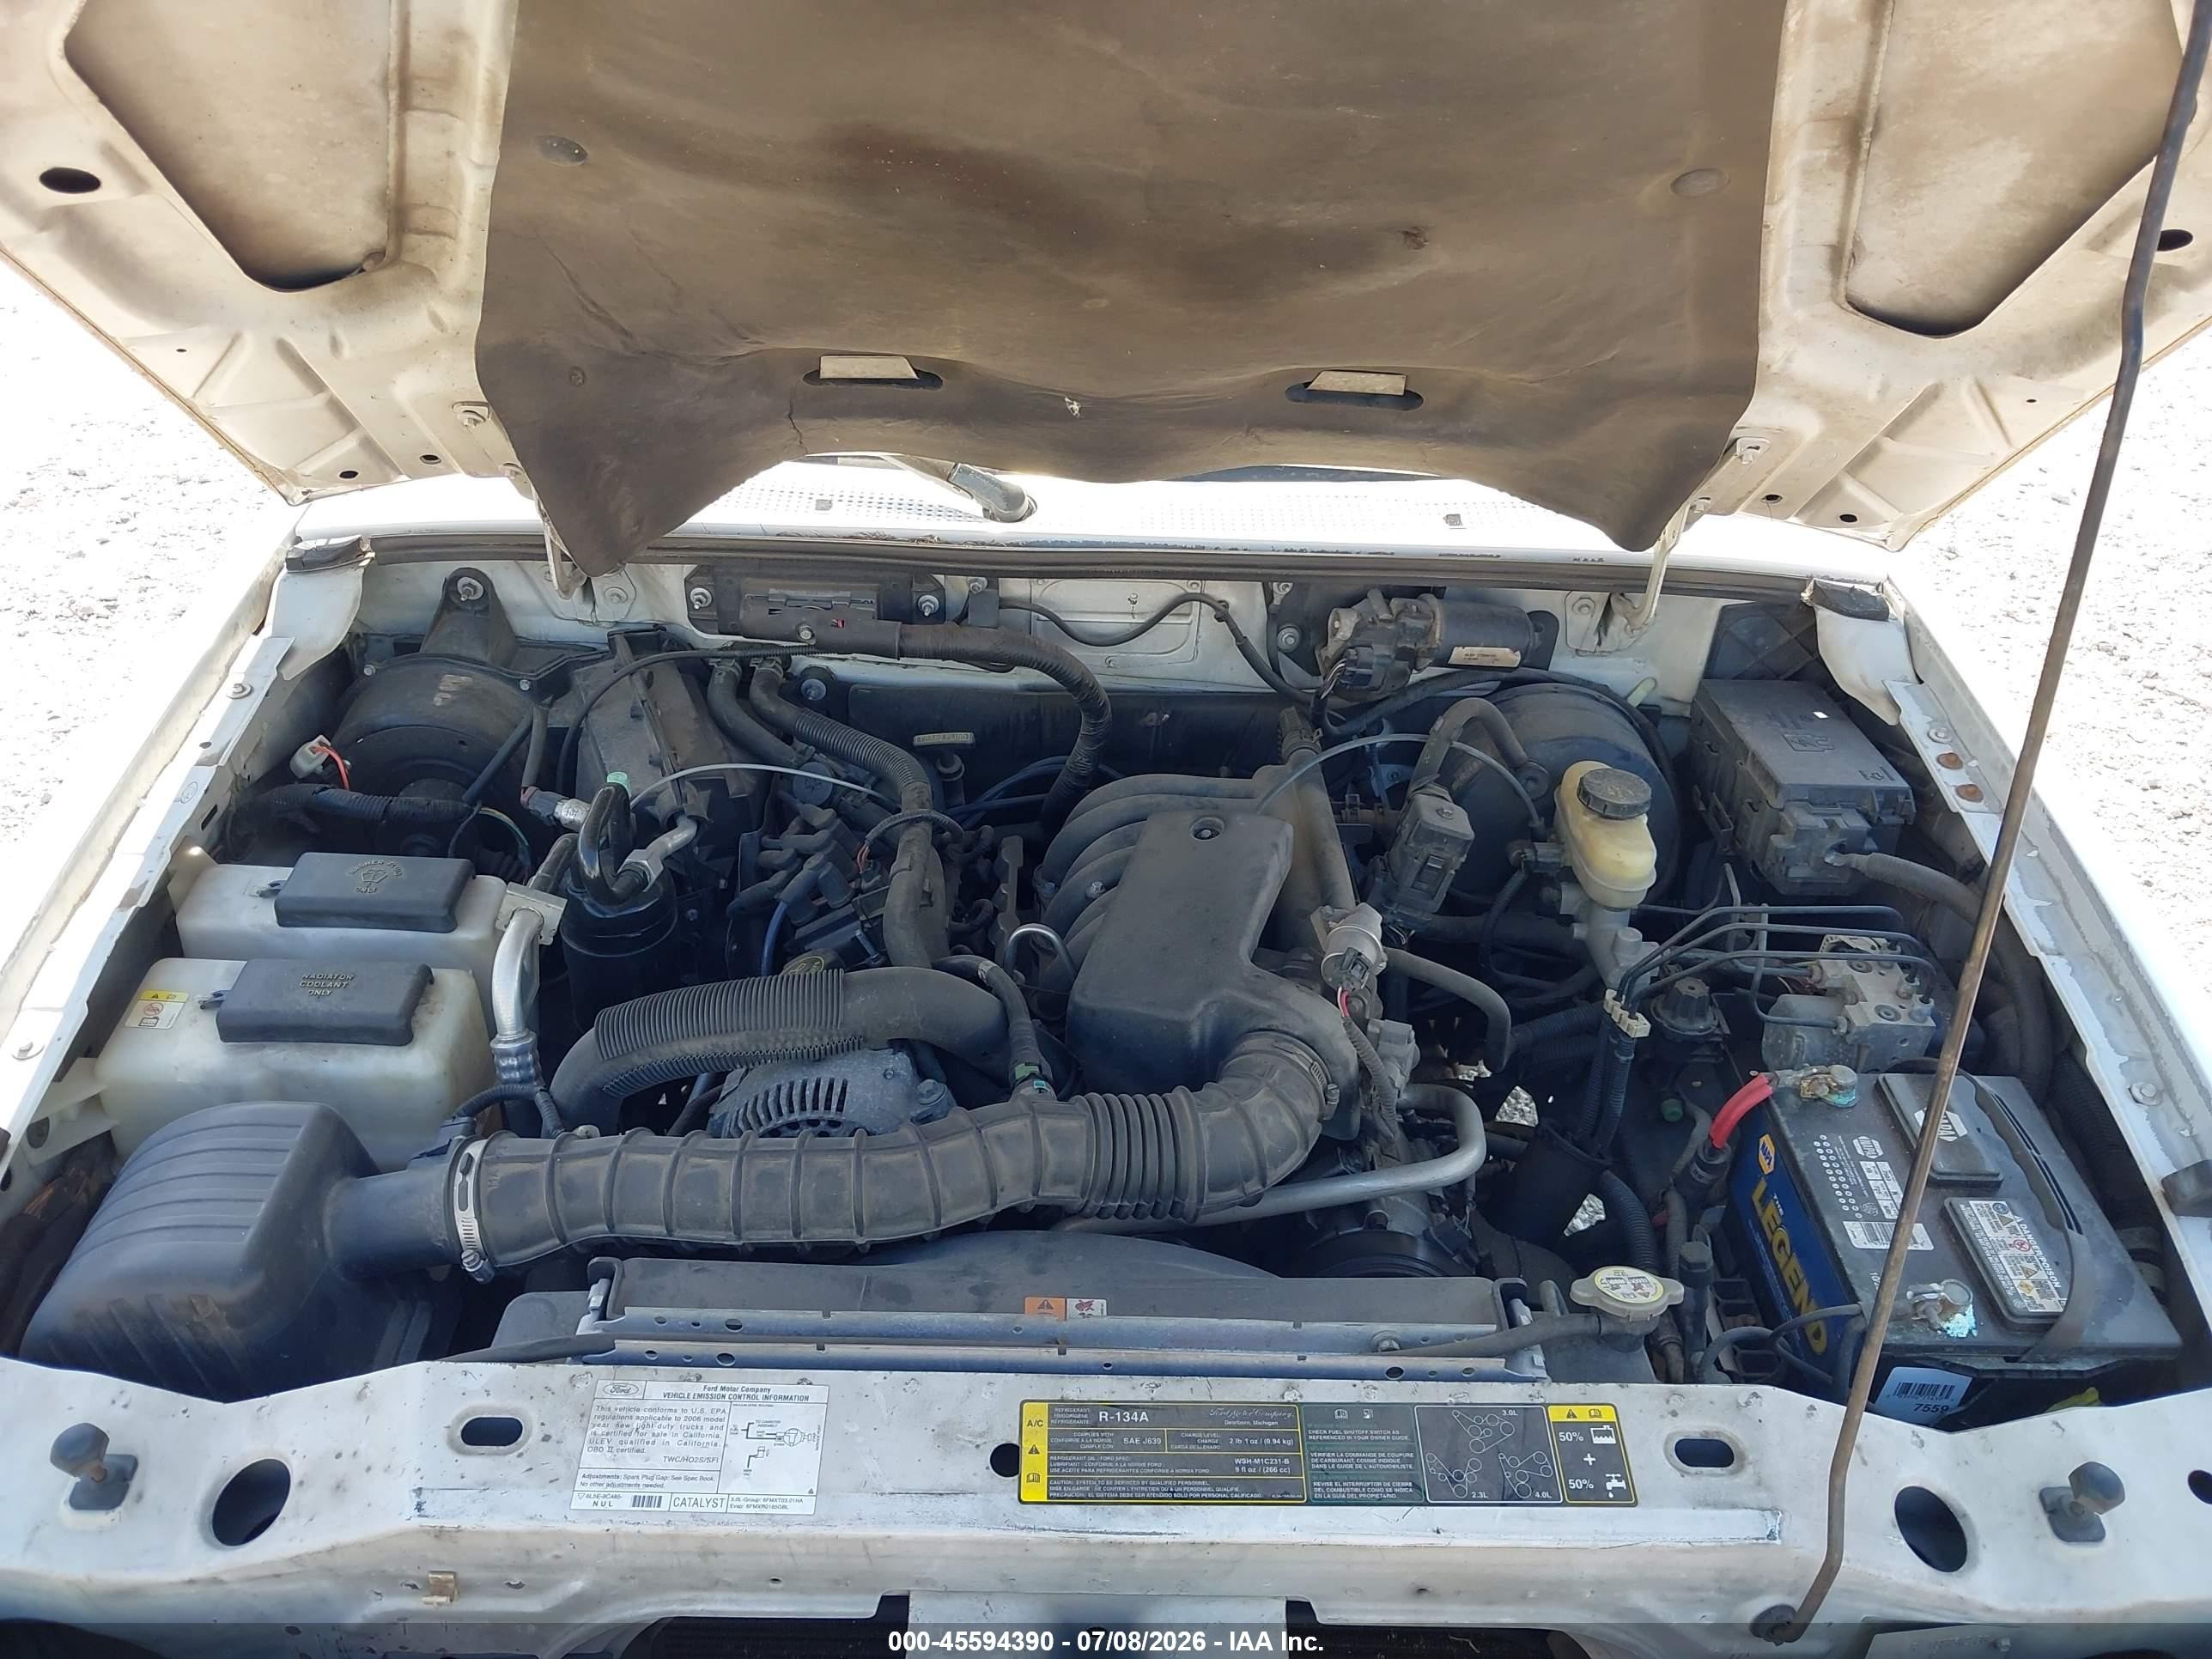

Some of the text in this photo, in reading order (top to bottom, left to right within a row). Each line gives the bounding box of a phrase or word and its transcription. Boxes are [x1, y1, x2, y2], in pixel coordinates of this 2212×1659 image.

[1773, 1193, 1784, 1217] THE
[1752, 1176, 1828, 1355] LEGEND
[611, 1385, 632, 1394] Ford
[1914, 1403, 1950, 1414] 7559
[1099, 1411, 1149, 1423] R-134A
[1027, 1419, 1044, 1428] A/C
[1282, 1438, 1294, 1446] kg)
[1559, 1431, 1584, 1443] 50%
[1568, 1479, 1594, 1490] 50%
[673, 1497, 725, 1508] CATALYST
